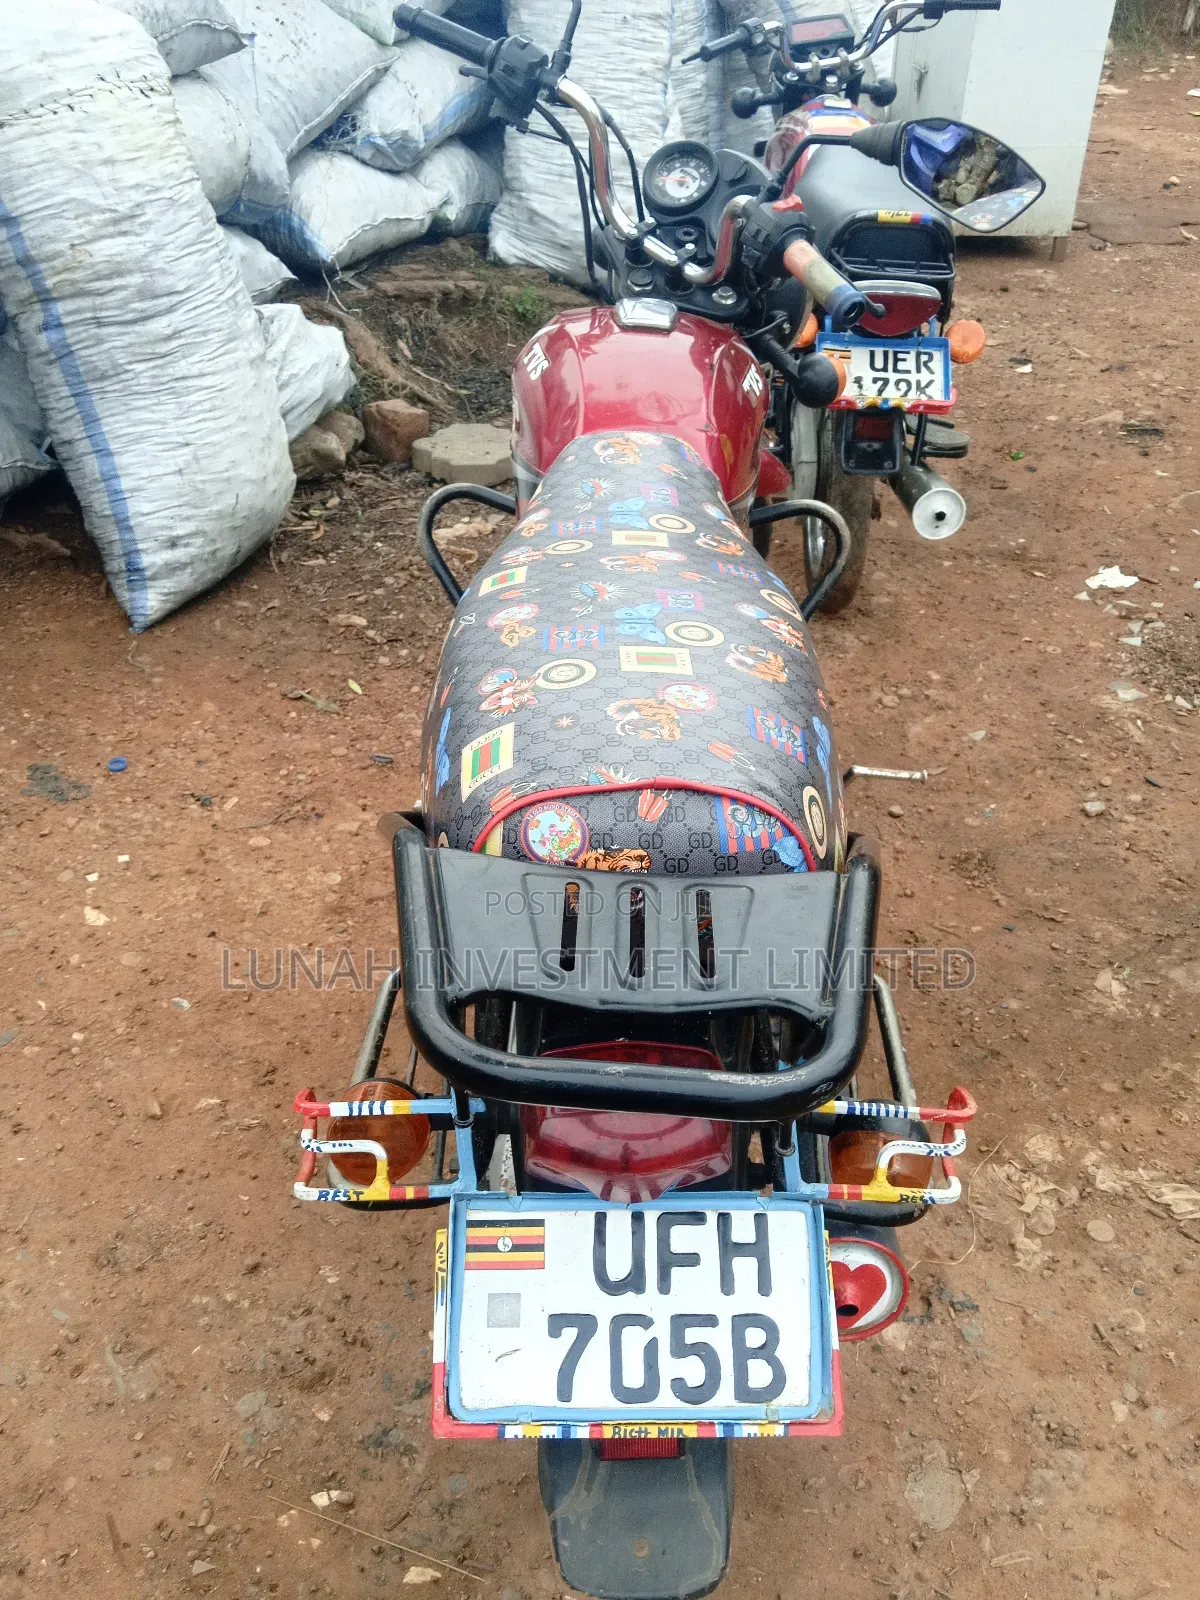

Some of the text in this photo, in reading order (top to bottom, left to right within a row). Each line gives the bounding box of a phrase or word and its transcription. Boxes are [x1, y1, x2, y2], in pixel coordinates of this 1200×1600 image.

[523, 342, 549, 381] TVS
[869, 349, 935, 375] UER
[614, 806, 637, 822] GD
[639, 832, 663, 849] GD
[689, 832, 712, 849] GD
[664, 858, 689, 873] GD
[714, 856, 738, 871] GD
[317, 1188, 365, 1201] BEST
[592, 1211, 773, 1297] UFH
[547, 1312, 787, 1406] 705B
